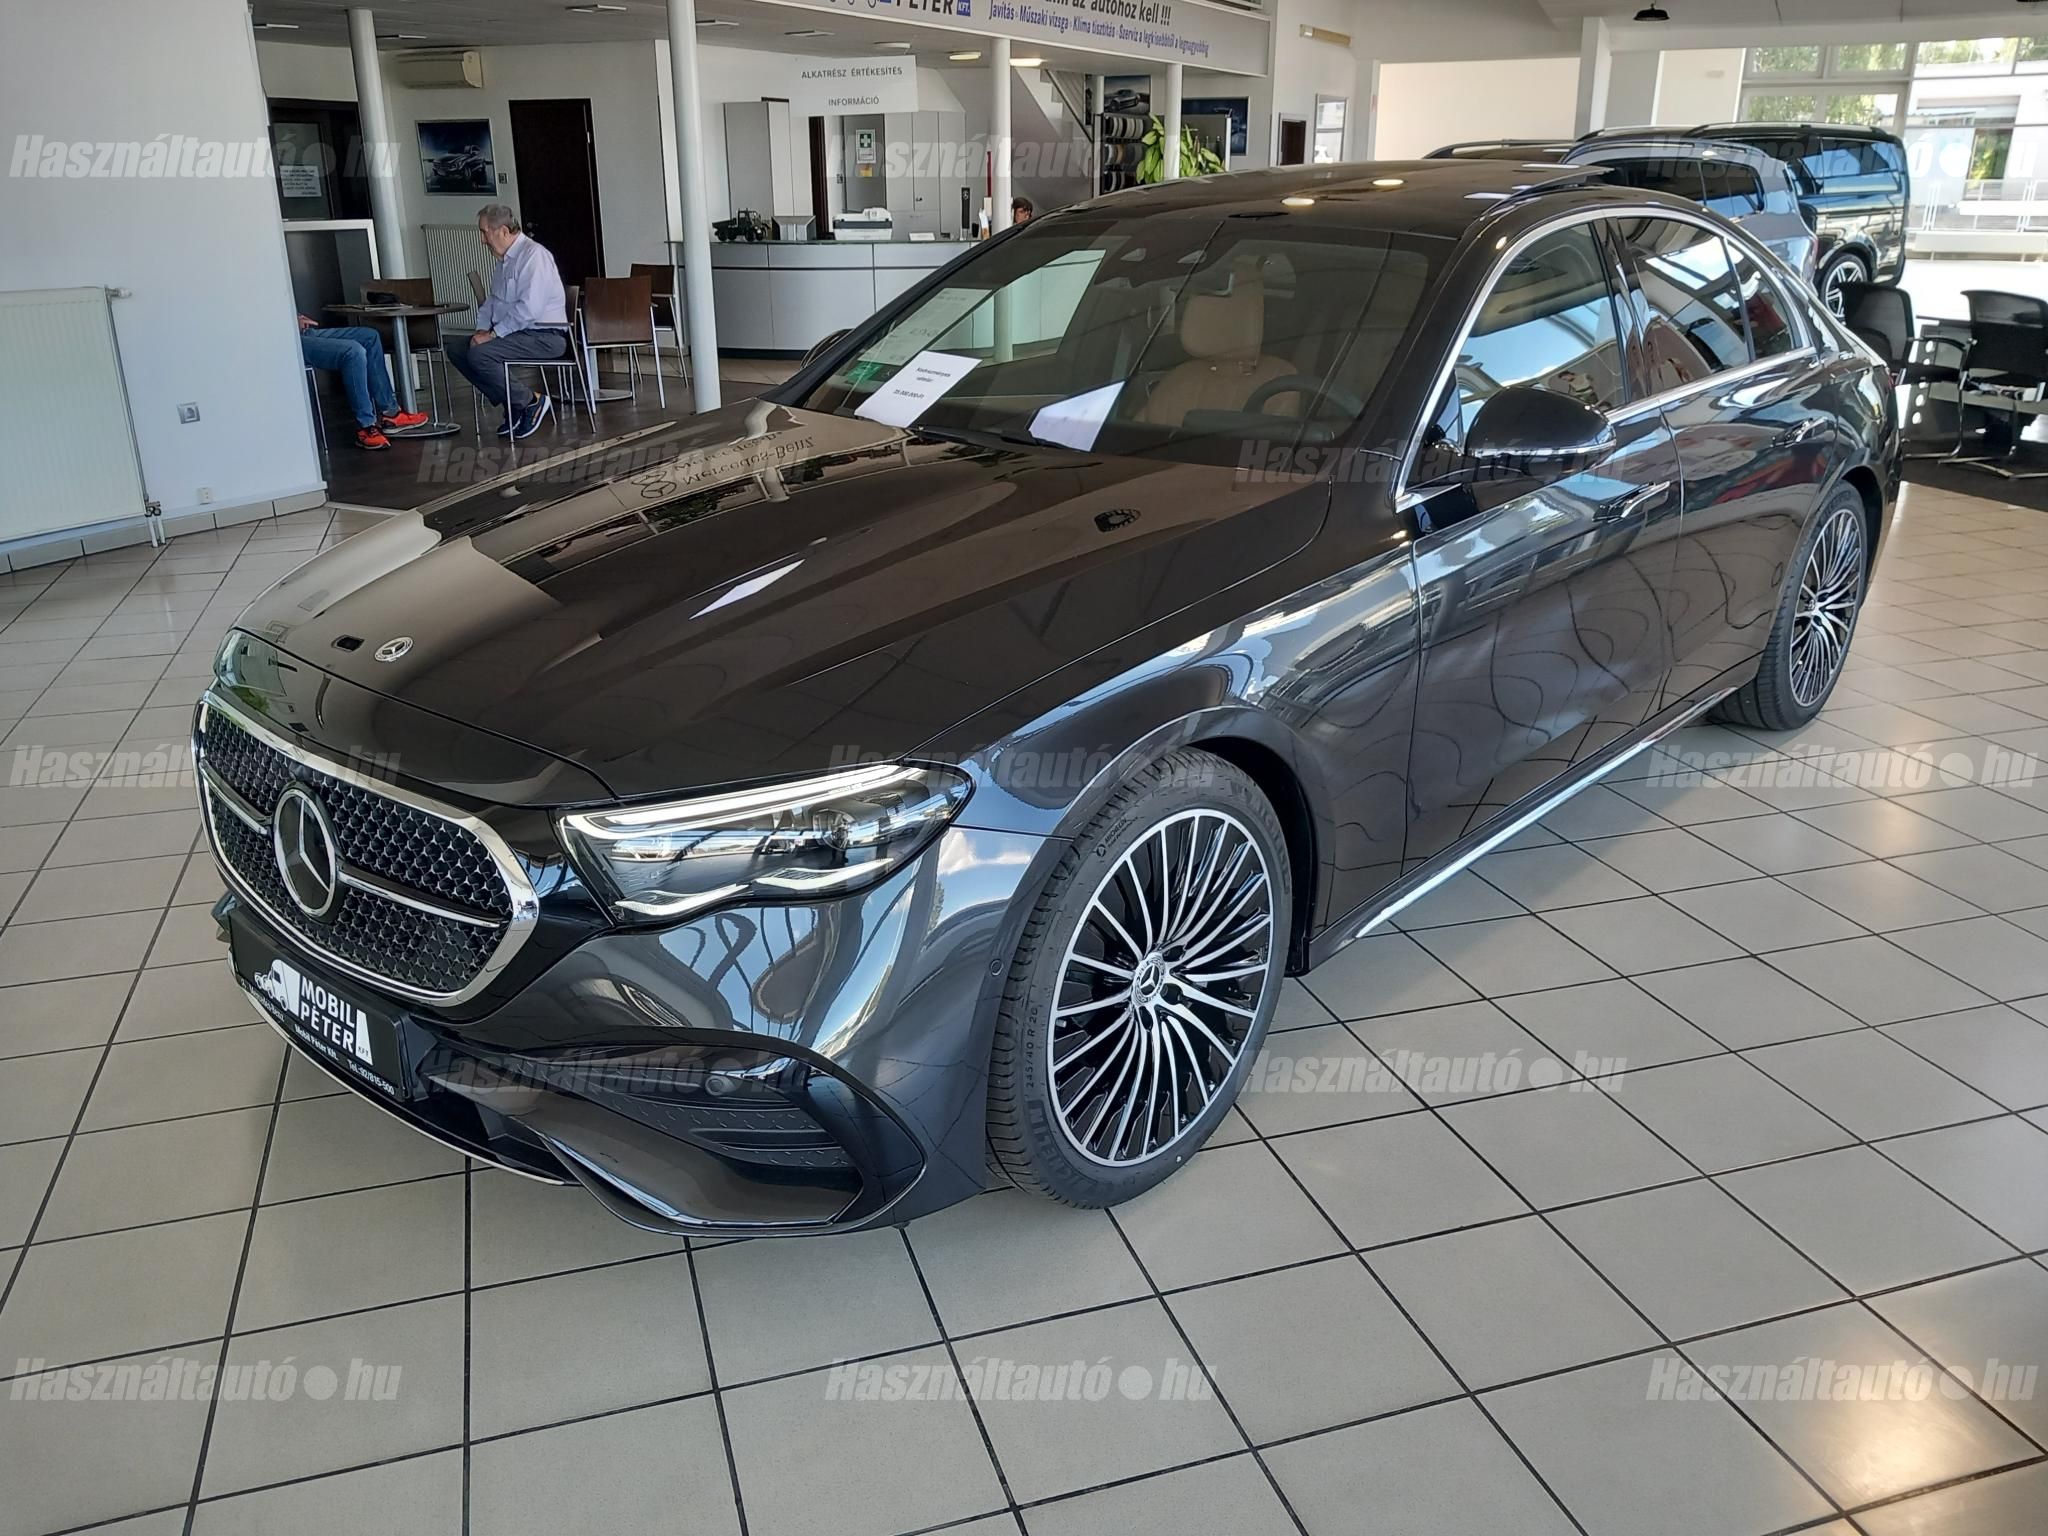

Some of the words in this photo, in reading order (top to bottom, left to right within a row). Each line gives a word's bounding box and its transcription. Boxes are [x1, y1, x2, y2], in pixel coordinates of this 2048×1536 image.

[1049, 12, 1069, 34] vizsga
[1139, 1, 1159, 23] kell
[801, 67, 847, 79] ALKATRÉSZ
[851, 66, 903, 78] ÉRTÉKESÍTÉS
[828, 95, 880, 107] INFORMÁCIÓ
[301, 975, 355, 1029] MOBIL
[301, 1001, 354, 1053] PÉTER
